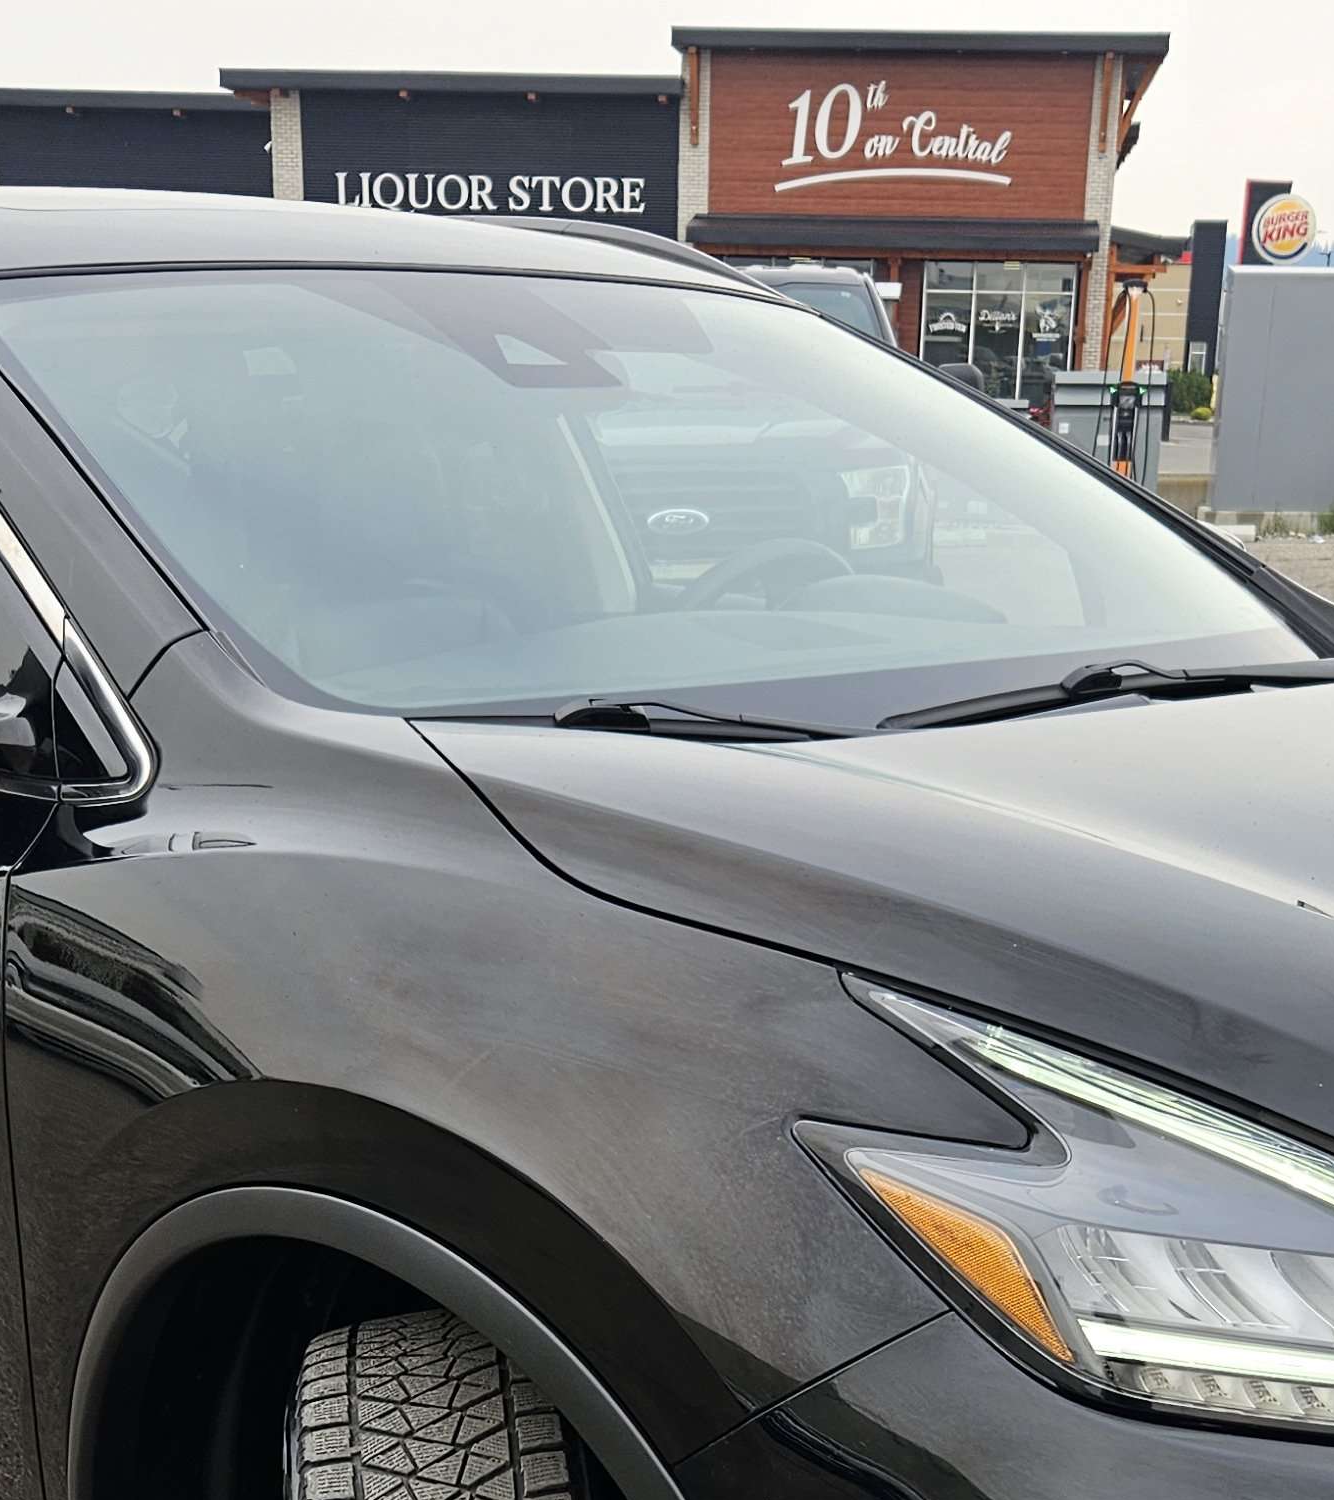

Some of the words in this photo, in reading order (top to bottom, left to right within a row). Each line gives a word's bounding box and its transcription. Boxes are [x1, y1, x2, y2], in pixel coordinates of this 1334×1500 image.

[864, 133, 901, 160] on
[902, 110, 1012, 164] Central
[335, 172, 498, 212] LIQUOR
[508, 175, 646, 213] STORE
[1262, 222, 1308, 245] KING
[1264, 209, 1309, 226] BURGER
